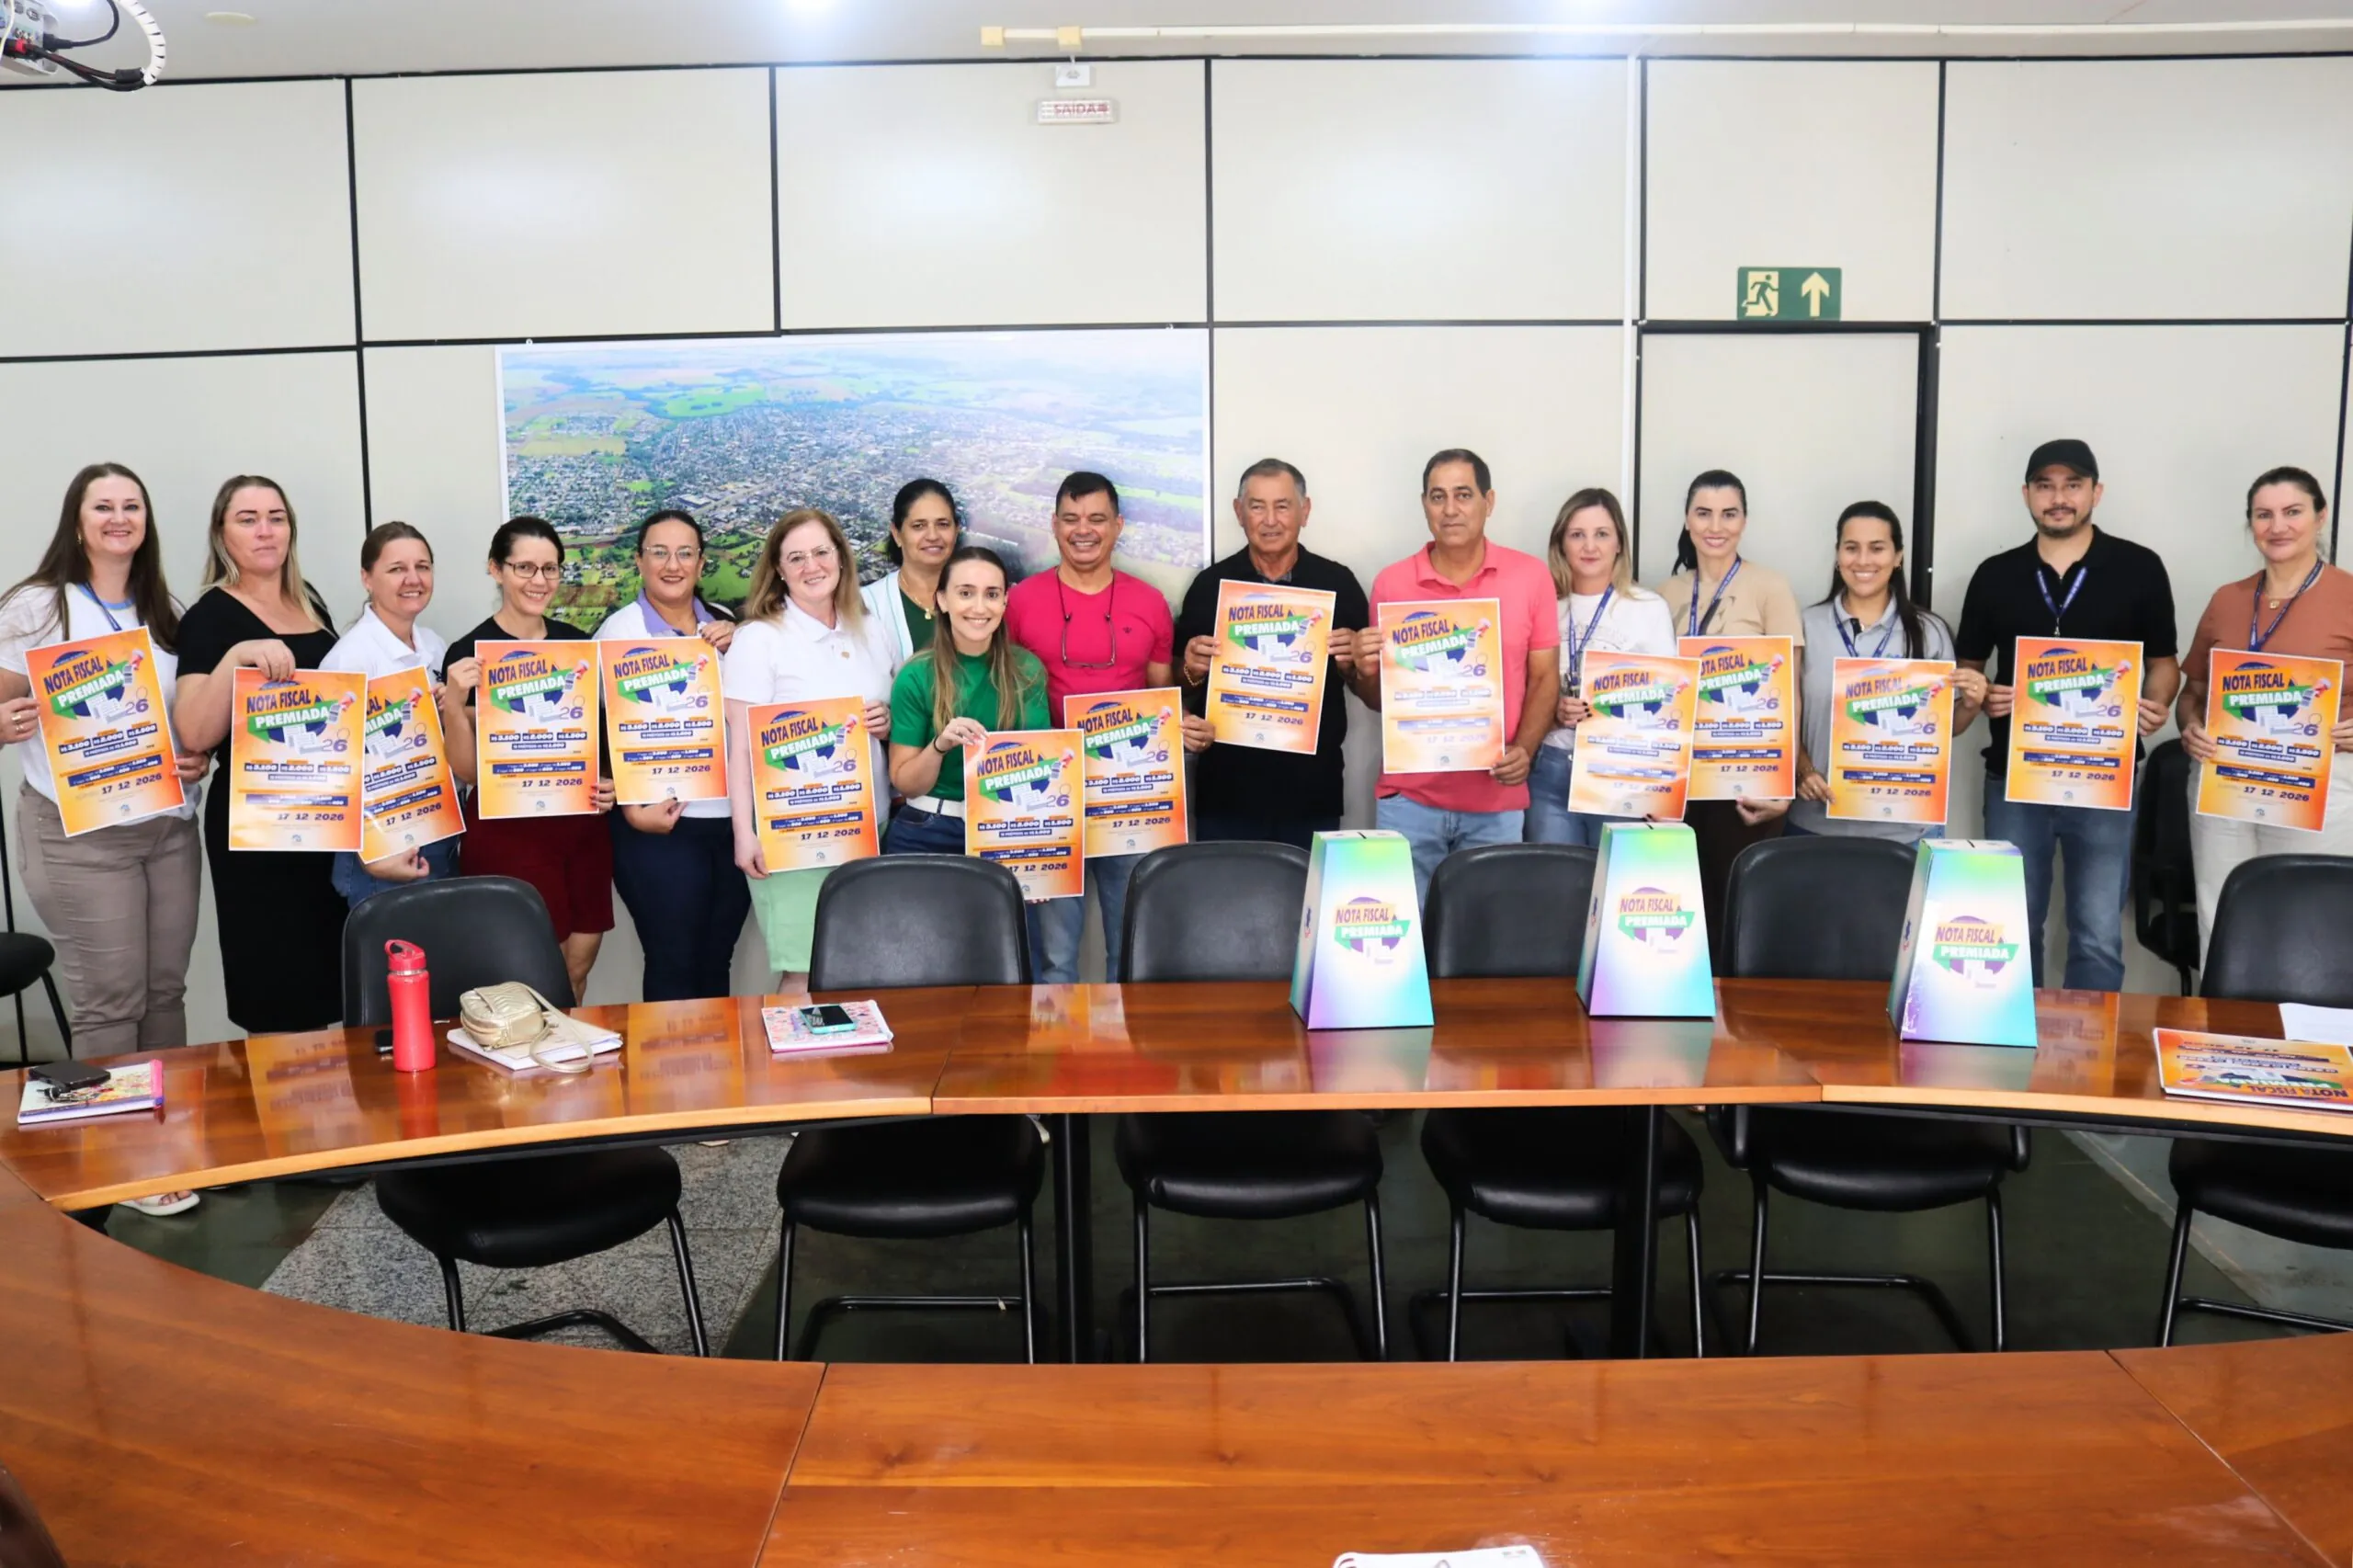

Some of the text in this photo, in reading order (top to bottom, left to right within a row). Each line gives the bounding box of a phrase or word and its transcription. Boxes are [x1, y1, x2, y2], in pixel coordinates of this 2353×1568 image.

[1228, 603, 1283, 621] NOTA FISCAL
[1234, 619, 1298, 635] PREMIADA
[1392, 618, 1449, 646] NOTA FISCAL
[1401, 633, 1467, 660] PREMIADA
[488, 658, 547, 686] NOTA FISCAL
[614, 653, 670, 679] NOTA FISCAL
[1717, 653, 1745, 672] FISCAL
[2027, 657, 2087, 679] NOTA FISCAL
[43, 655, 104, 695] NOTA FISCAL
[622, 667, 688, 692] PREMIADA
[1594, 671, 1650, 691] NOTA FISCAL
[2034, 674, 2104, 693] PREMIADA
[2222, 673, 2284, 691] NOTA FISCAL
[56, 669, 124, 708] PREMIADA
[496, 675, 564, 699] PREMIADA
[1600, 687, 1664, 705] PREMIADA
[1845, 676, 1903, 699] NOTA FISCAL
[246, 688, 311, 713] NOTA FISCAL
[1852, 692, 1918, 712] PREMIADA
[2229, 690, 2301, 706] PREMIADA
[255, 706, 328, 728] PREMIADA
[1076, 708, 1132, 733] NOTA FISCAL
[1260, 713, 1273, 722] 12
[1277, 715, 1303, 725] 2026
[760, 716, 818, 746] NOTA FISCAL
[1086, 722, 1149, 748] PREMIADA
[770, 730, 835, 759] PREMIADA
[652, 764, 712, 775] 17 12 2026
[976, 749, 1034, 777] NOTA FISCAL
[100, 771, 163, 795] 17 12 2026
[521, 778, 583, 788] 17 12 2026
[984, 764, 1051, 790] PREMIADA
[2086, 772, 2115, 781] 2026
[2244, 785, 2310, 801] 17 12 2026
[277, 812, 289, 820] 17
[313, 812, 344, 821] 2026
[381, 801, 442, 826] 17 12 2026
[1111, 816, 1171, 828] 17 12 2026
[800, 827, 860, 841] 17 12 2026
[1040, 862, 1067, 870] 2026
[1620, 898, 1674, 913] NOTA FISCAL
[1336, 908, 1389, 925] NOTA FISCAL
[1935, 926, 1995, 944] NOTA FISCAL
